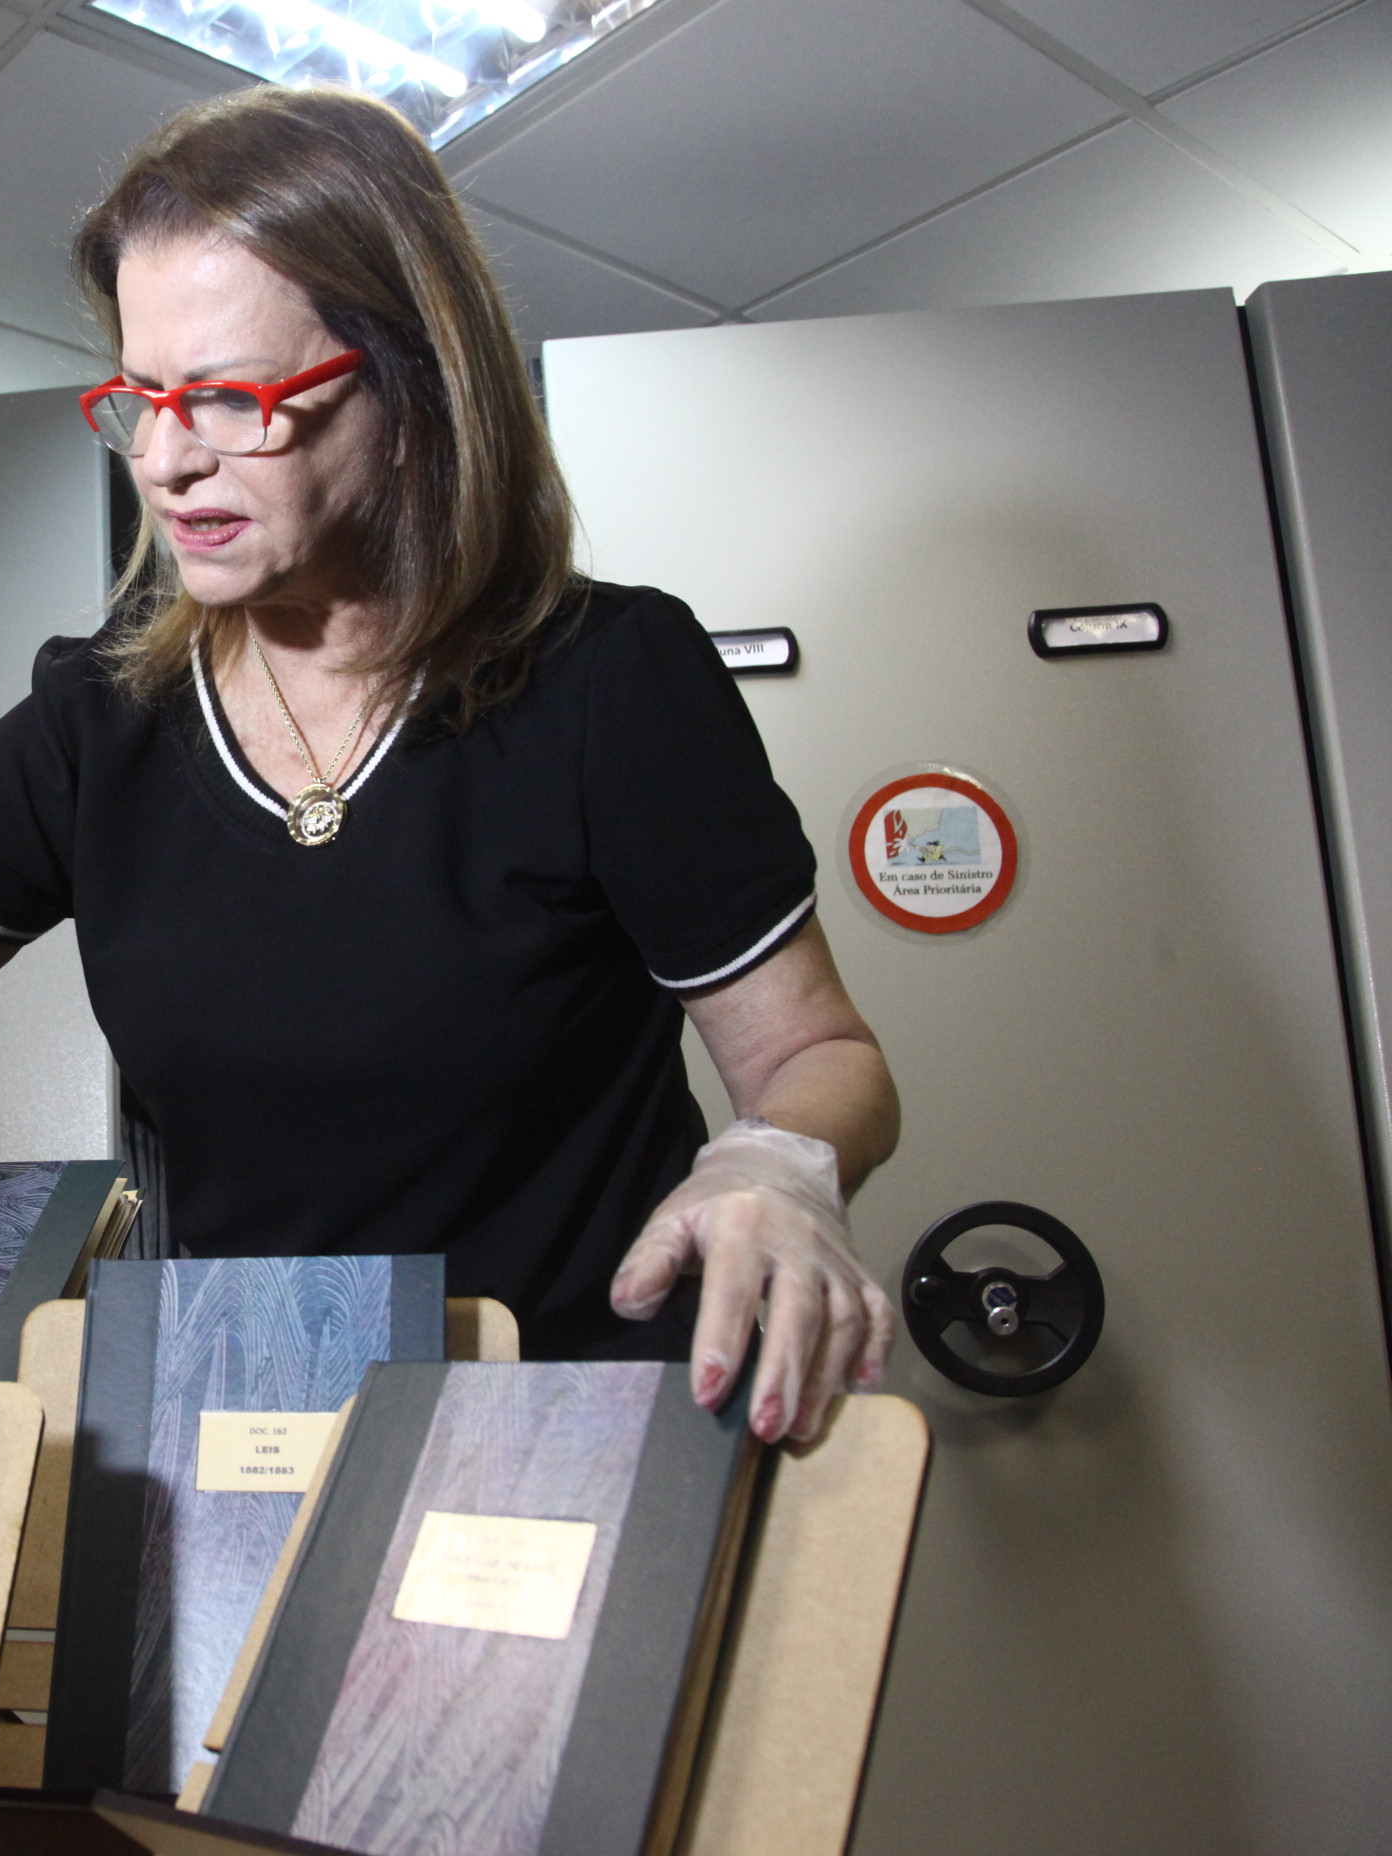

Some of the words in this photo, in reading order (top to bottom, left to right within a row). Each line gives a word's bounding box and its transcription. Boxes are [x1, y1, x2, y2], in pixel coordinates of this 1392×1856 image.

[1069, 621, 1112, 632] Coluna
[743, 643, 764, 655] VIII
[879, 871, 898, 882] Em
[902, 872, 926, 881] caso
[930, 869, 944, 880] de
[947, 868, 993, 880] Sinistro
[893, 883, 920, 896] Área
[923, 884, 982, 895] Prioritária
[273, 1427, 287, 1435] 162
[255, 1446, 280, 1454] LEIS
[240, 1467, 295, 1475] 1882/1883
